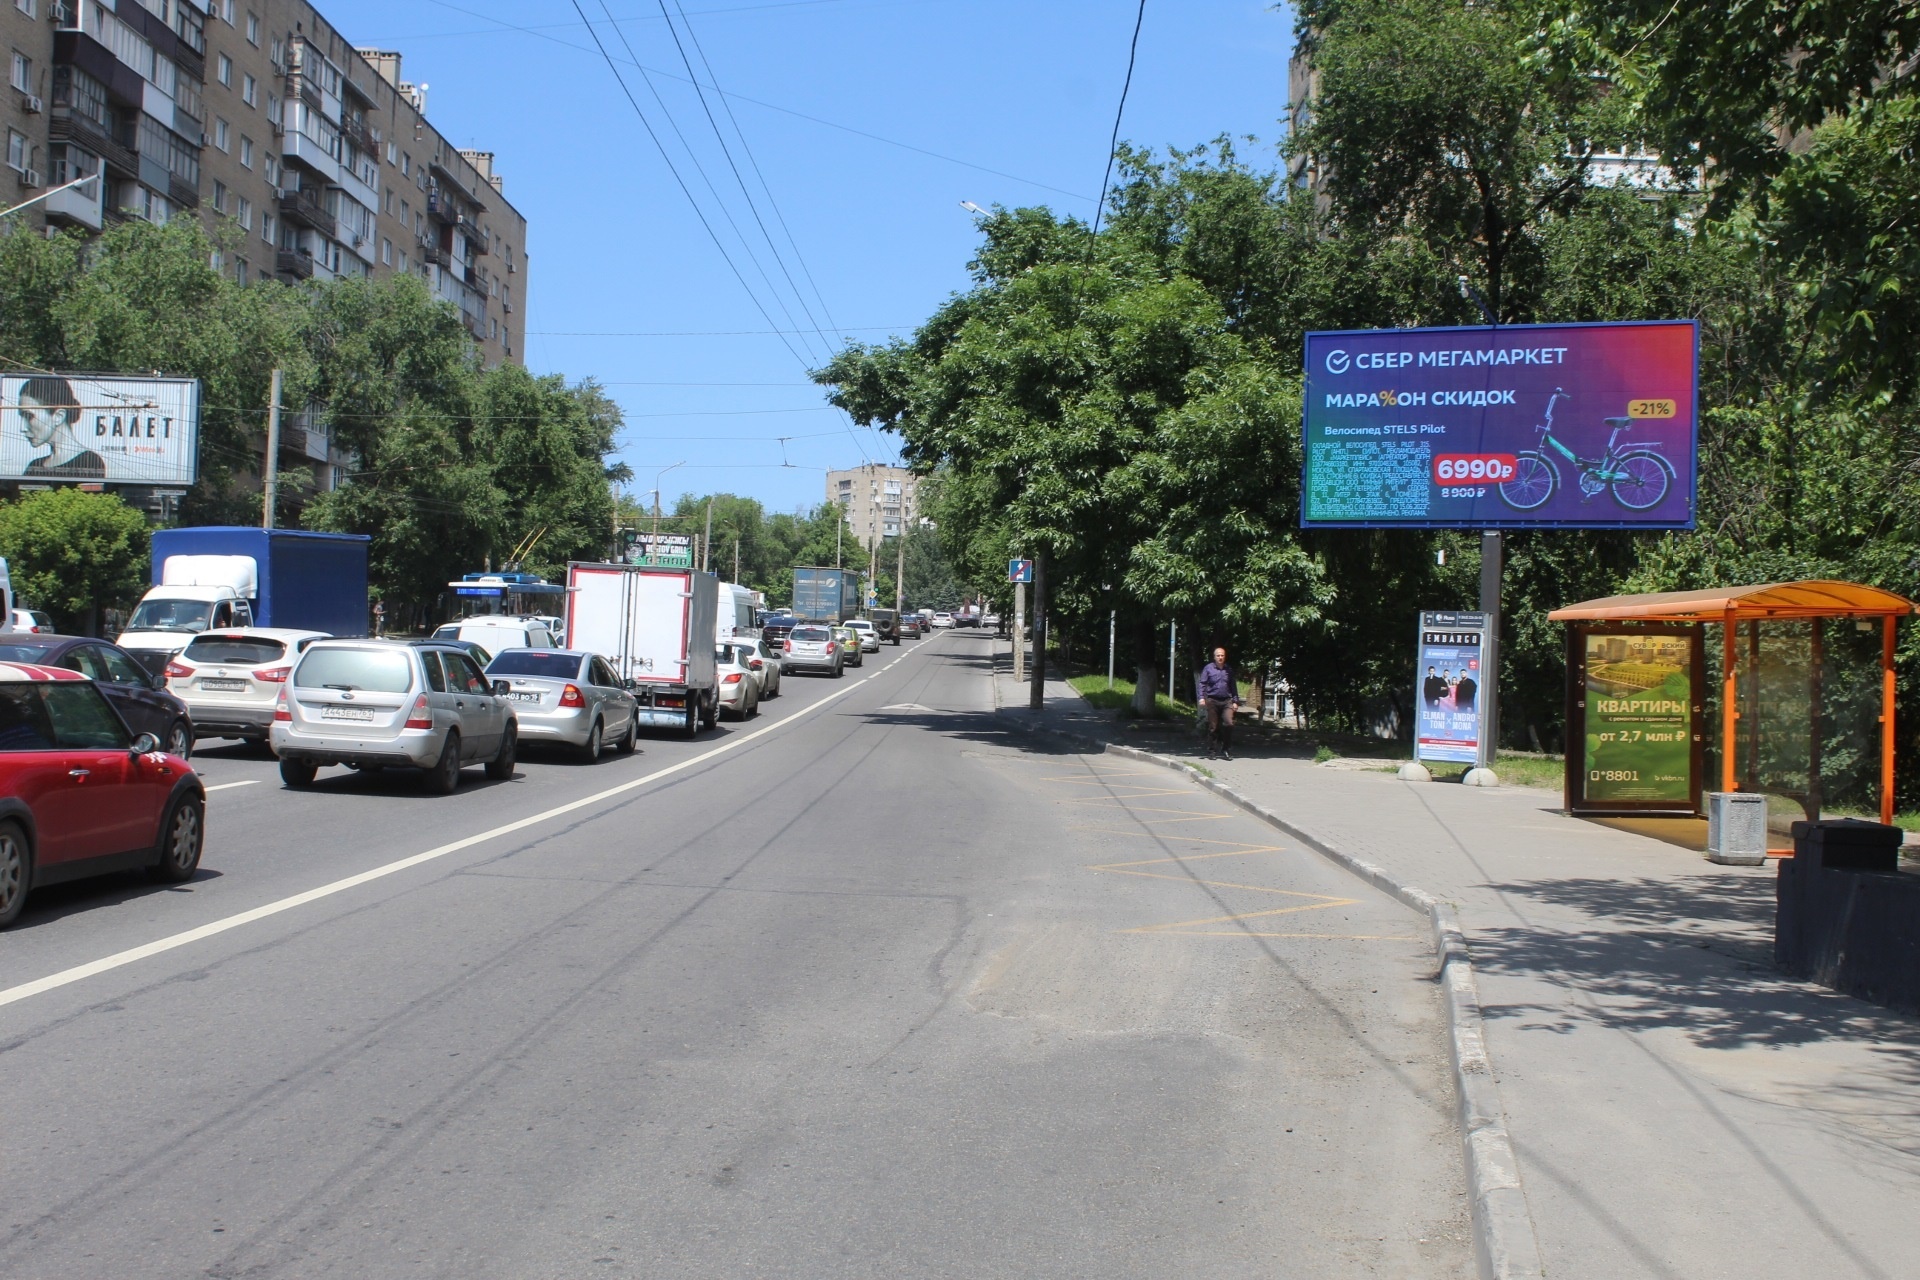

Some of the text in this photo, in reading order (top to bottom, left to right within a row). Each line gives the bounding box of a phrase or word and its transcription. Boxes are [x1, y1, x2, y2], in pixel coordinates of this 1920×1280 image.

[1356, 348, 1568, 369] СБЕР МЕГАМАРКЕТ
[1325, 389, 1516, 408] МАРА%ОН СКИДОК
[1633, 402, 1670, 415] -21%
[96, 415, 174, 439] БАЛЕТ
[1324, 424, 1446, 435] Велосипед STELS Pilot
[1438, 459, 1513, 479] 6990₽
[636, 534, 690, 544] МЫ ОКРЫЛИСЬ!
[646, 544, 688, 554] ROTOV GRILL
[1426, 634, 1478, 644] EMBARGO
[1633, 641, 1686, 649] СУВРВСКИЙ
[1597, 701, 1686, 713] КВАРТИРЫ
[1423, 711, 1446, 720] ELMAN
[1453, 712, 1476, 722] ANDRO
[1430, 720, 1446, 730] TONI
[1452, 722, 1472, 731] MONA
[1600, 732, 1616, 741] от
[1620, 730, 1642, 743] 2,7
